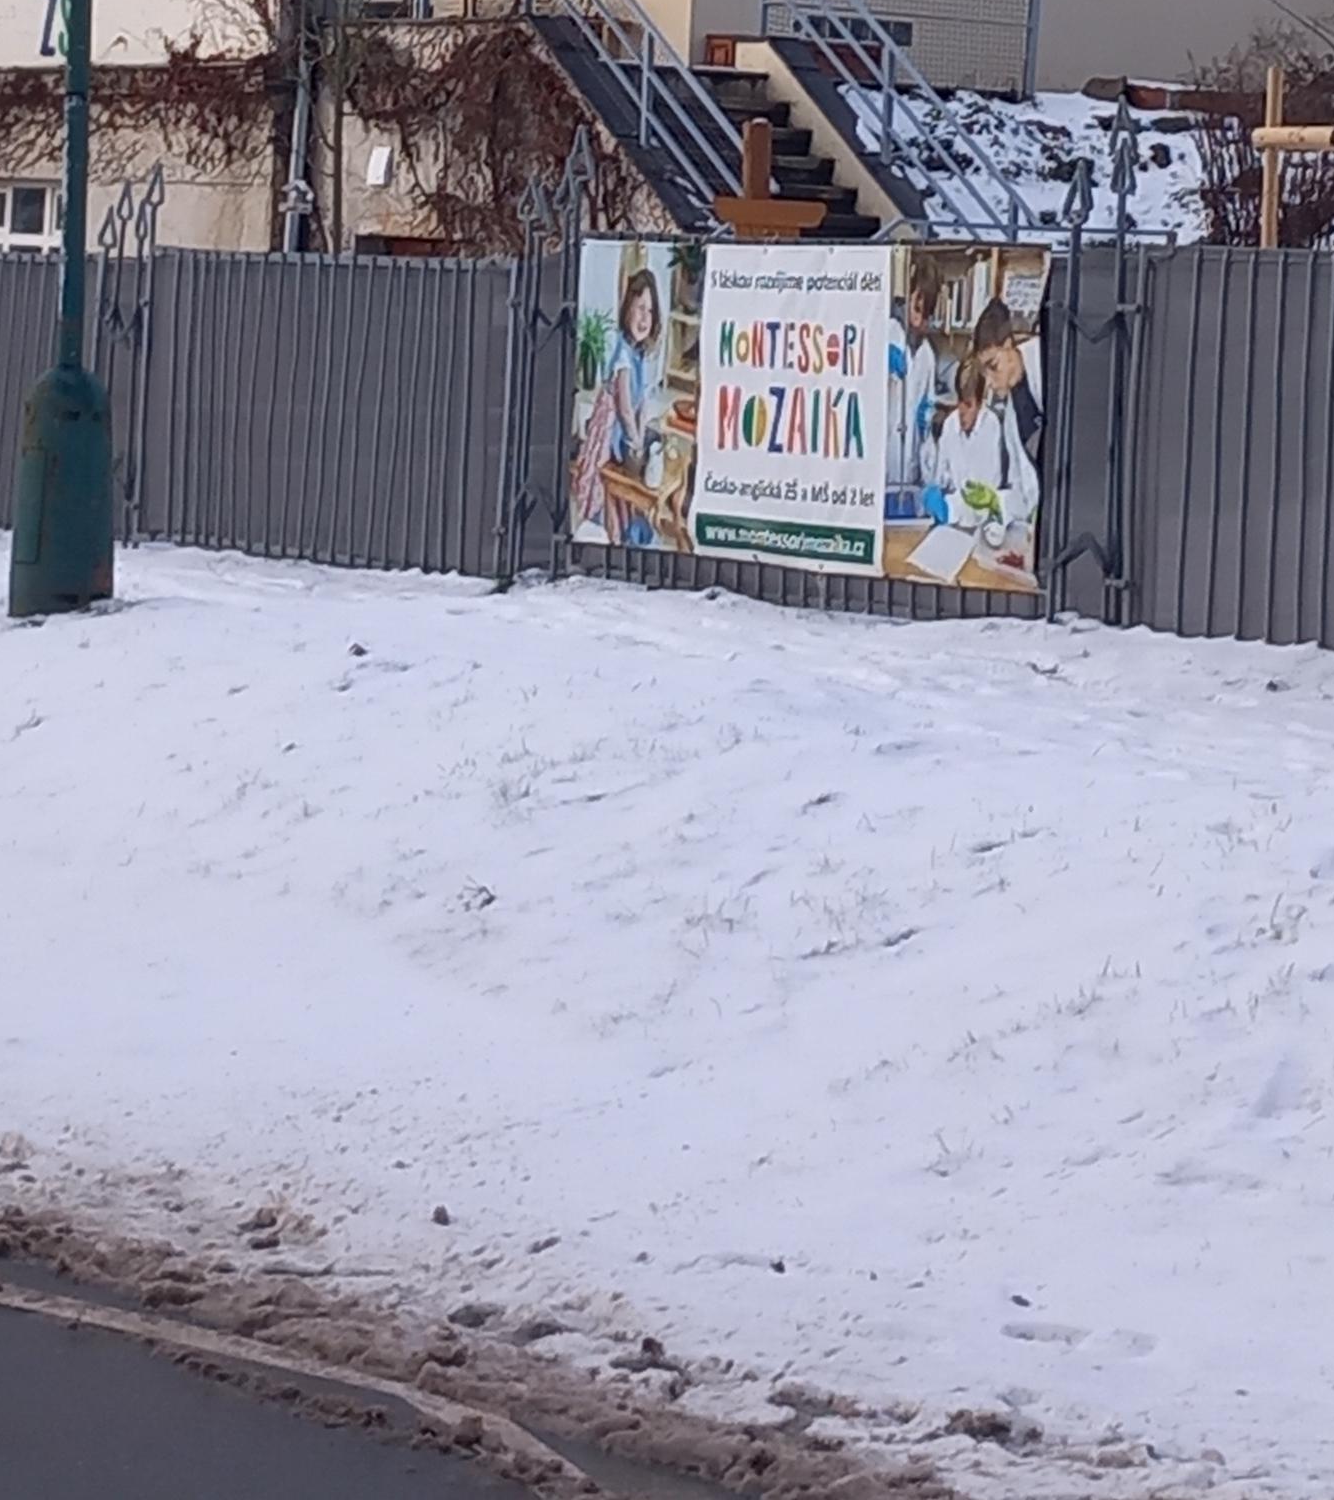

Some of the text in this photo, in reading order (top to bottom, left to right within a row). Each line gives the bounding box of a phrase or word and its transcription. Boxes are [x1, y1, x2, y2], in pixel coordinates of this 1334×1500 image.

[719, 269, 754, 290] láskou
[806, 270, 858, 294] potenciál
[719, 320, 865, 377] MONTESSORI
[718, 385, 864, 459] MOZAIKA
[811, 480, 830, 503] MŠ
[831, 486, 847, 506] od
[850, 487, 857, 506] 2
[859, 486, 875, 507] let
